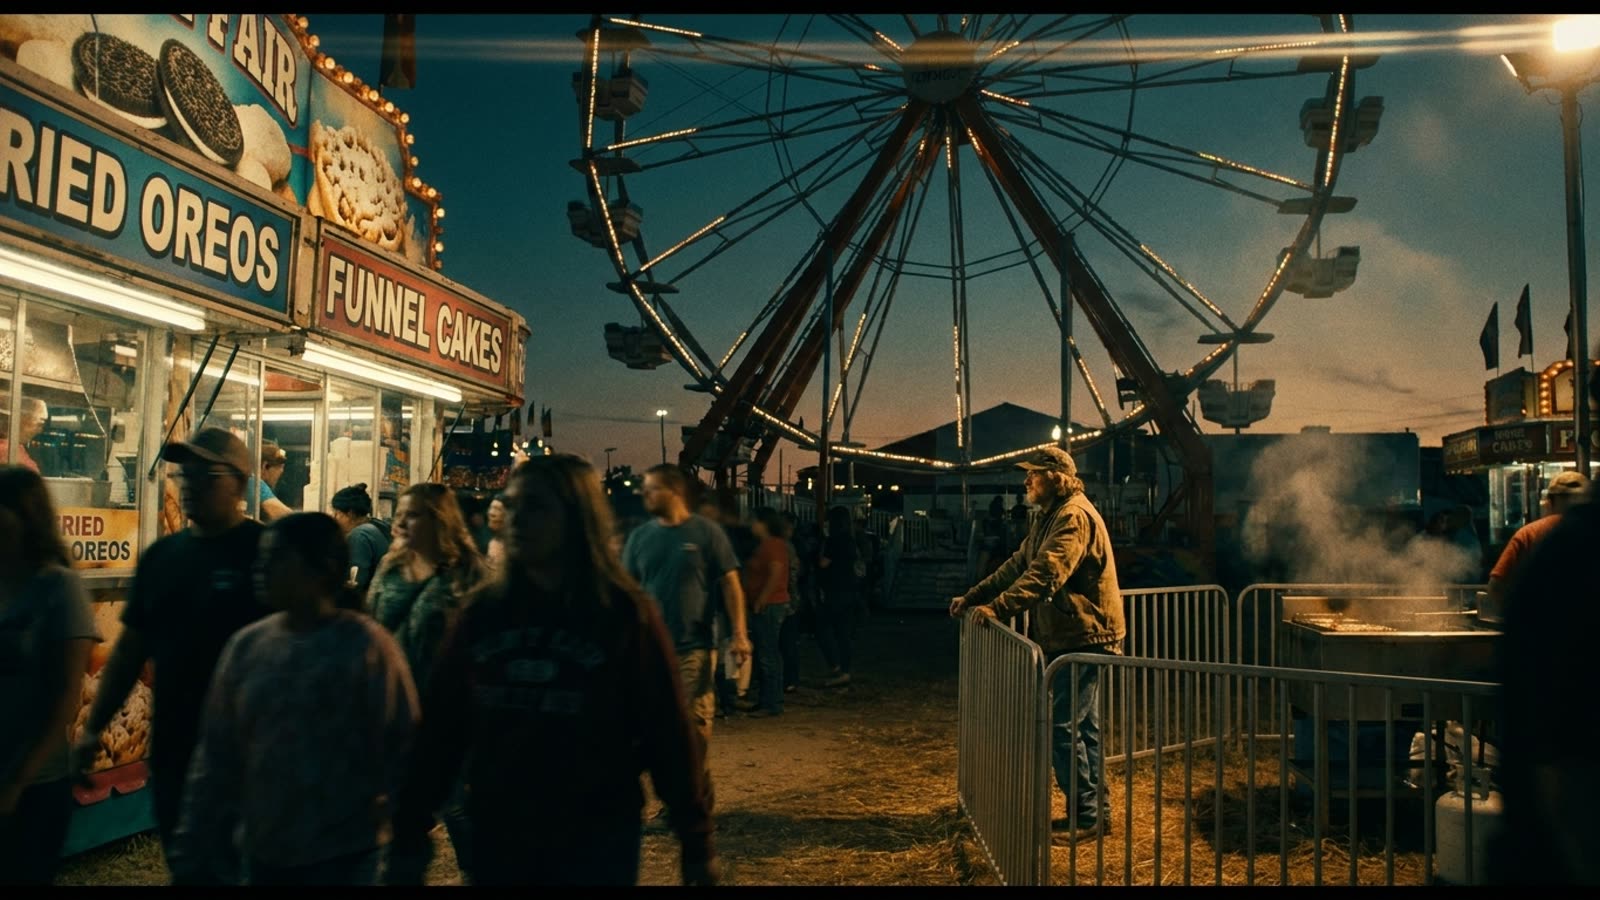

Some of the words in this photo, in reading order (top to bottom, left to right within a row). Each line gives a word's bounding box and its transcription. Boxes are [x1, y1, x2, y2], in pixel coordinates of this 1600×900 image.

[141, 176, 280, 292] OREOS
[325, 254, 430, 348] FUNNEL
[436, 304, 503, 374] CAKES
[71, 540, 131, 561] OREOS
